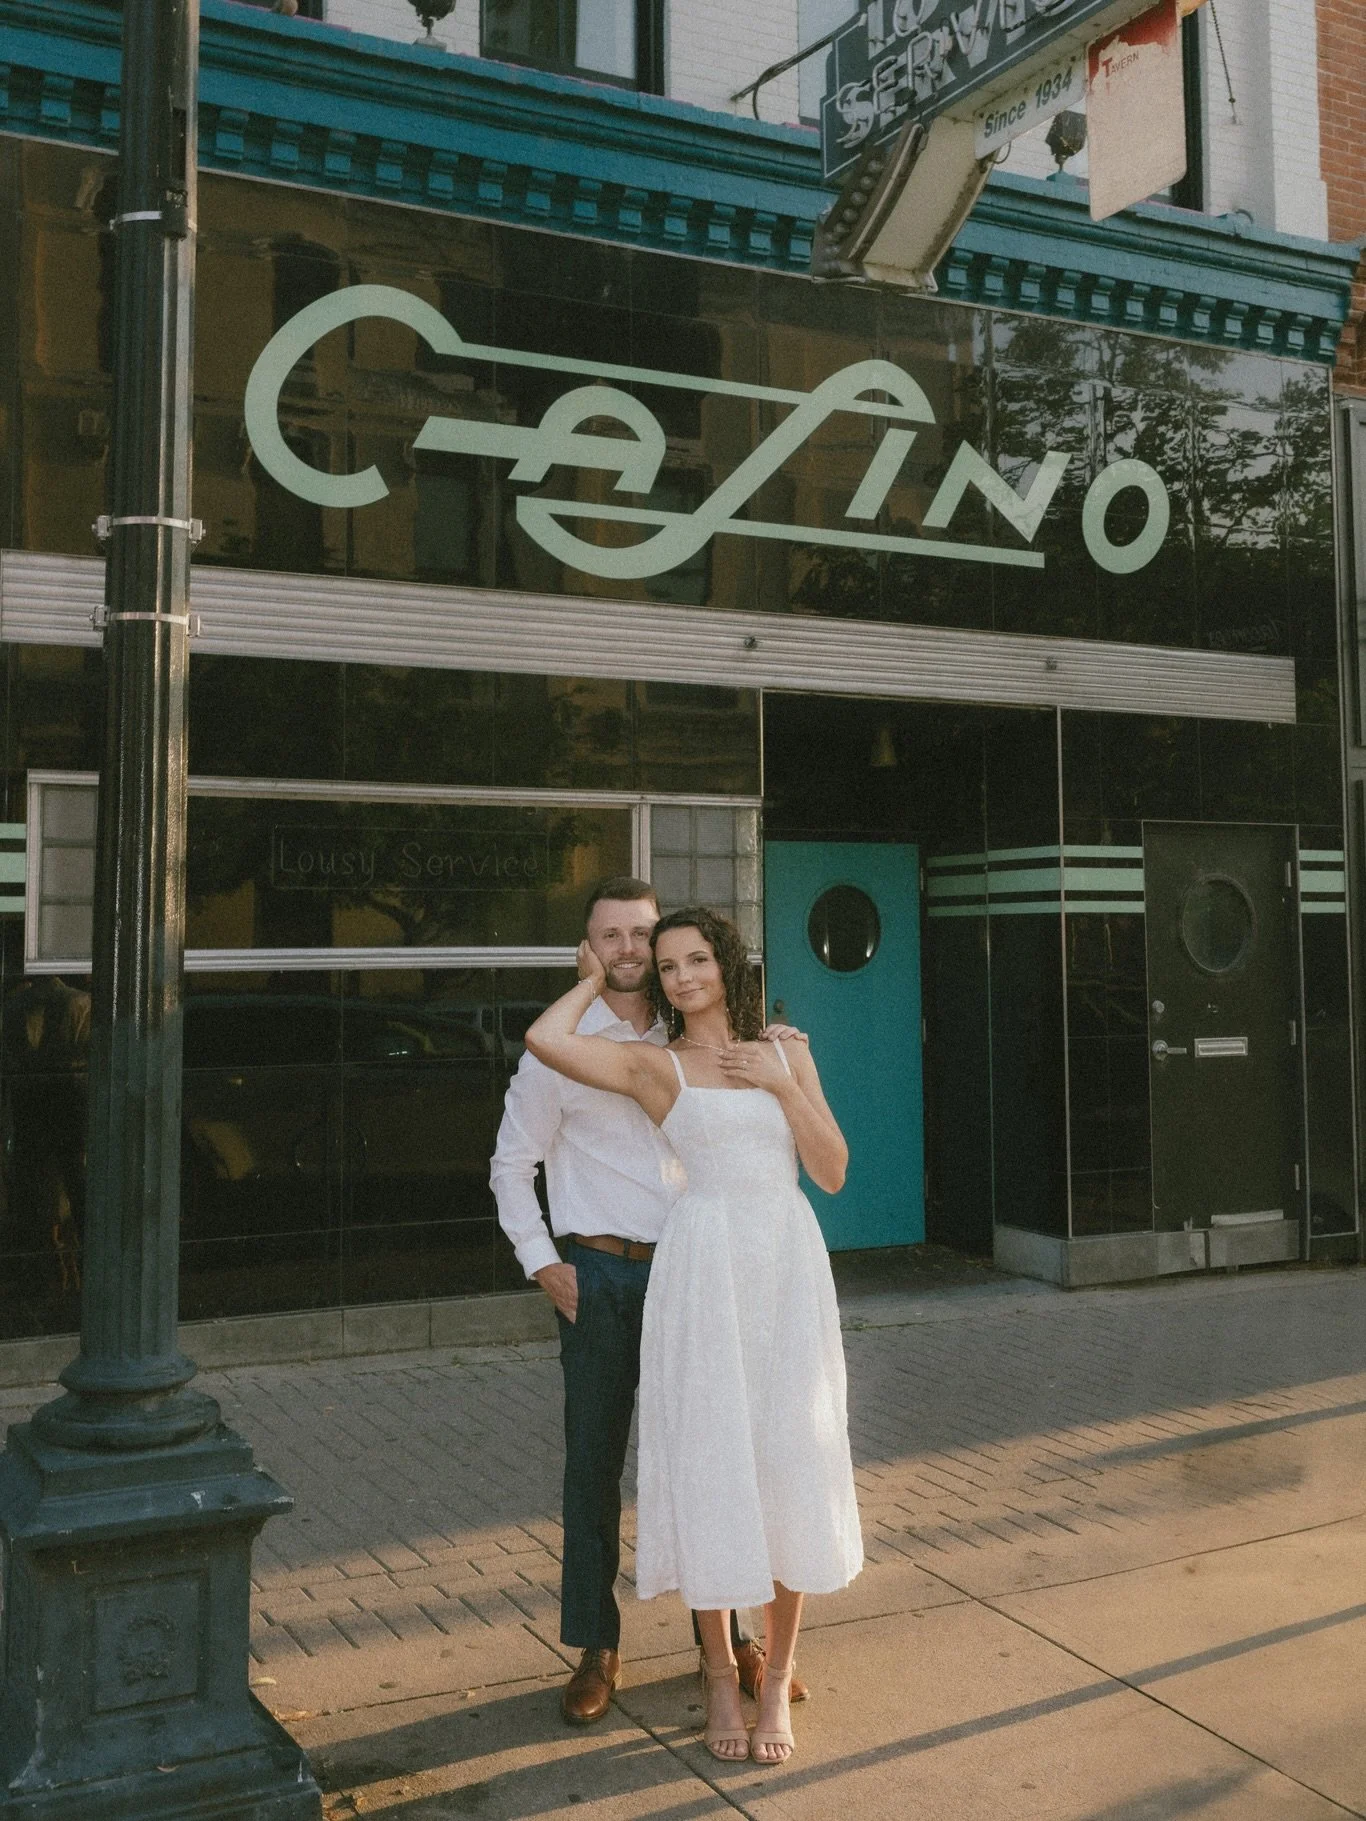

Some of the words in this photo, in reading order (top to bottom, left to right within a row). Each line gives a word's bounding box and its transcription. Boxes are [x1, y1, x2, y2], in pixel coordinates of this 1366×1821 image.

[984, 103, 1026, 138] Since
[1035, 68, 1074, 111] 1934
[280, 838, 375, 888] Lousy
[401, 842, 539, 879] Service
